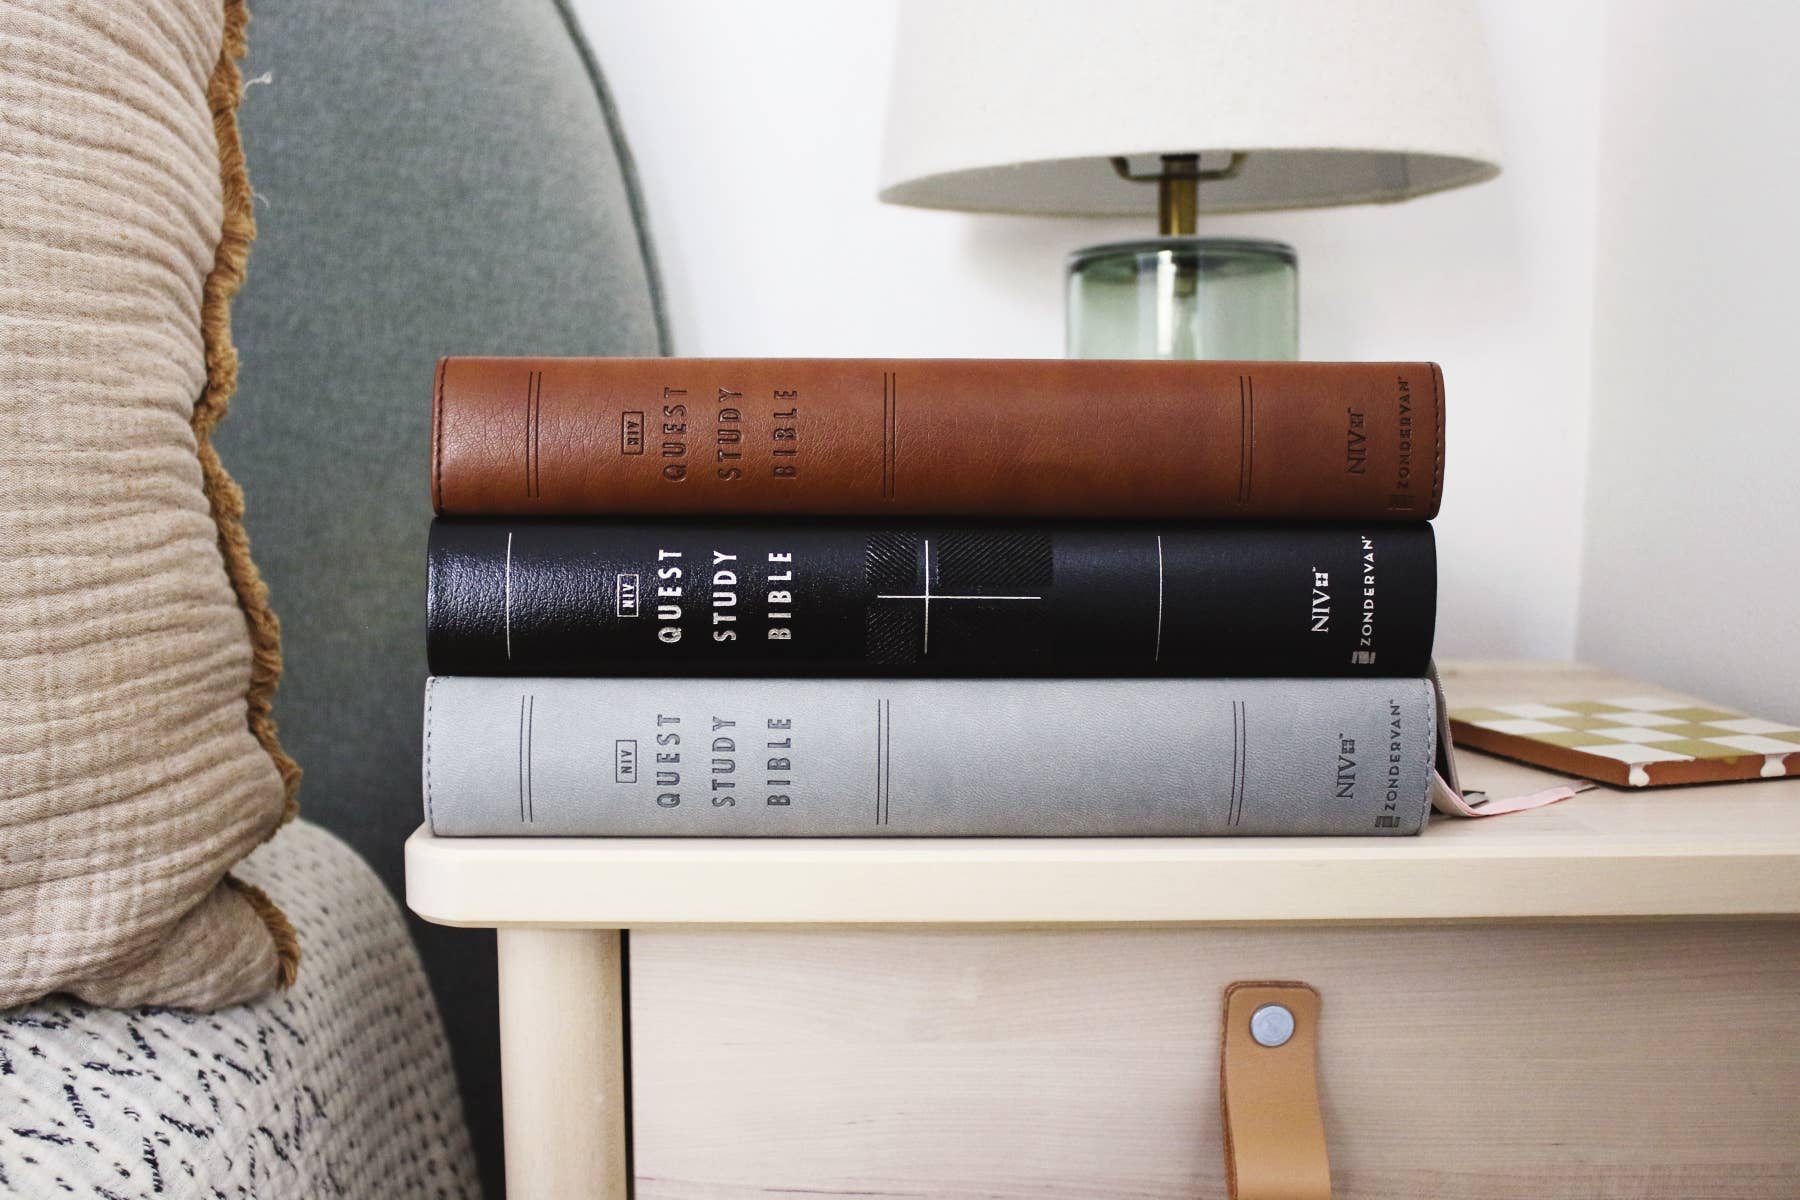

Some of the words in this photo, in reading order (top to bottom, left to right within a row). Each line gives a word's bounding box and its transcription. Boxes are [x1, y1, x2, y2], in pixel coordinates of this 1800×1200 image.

[627, 420, 640, 446] NIV
[663, 387, 687, 482] QUEST
[718, 388, 743, 481] STUDY
[774, 390, 798, 478] BIBLE
[1398, 379, 1413, 490] ZONDERVAN
[622, 583, 635, 608] NIV
[658, 549, 682, 643] QUEST
[713, 550, 737, 641] STUDY
[768, 552, 792, 640] BIBLE
[1311, 588, 1330, 633] NIV
[1360, 538, 1375, 646] ZONDERVAN
[620, 749, 633, 774] NIV
[656, 714, 681, 808] QUEST
[712, 716, 736, 807] STUDY
[767, 718, 792, 806] BIBLE
[1336, 754, 1356, 800] NIV
[1384, 703, 1401, 811] ZONDERVAN
